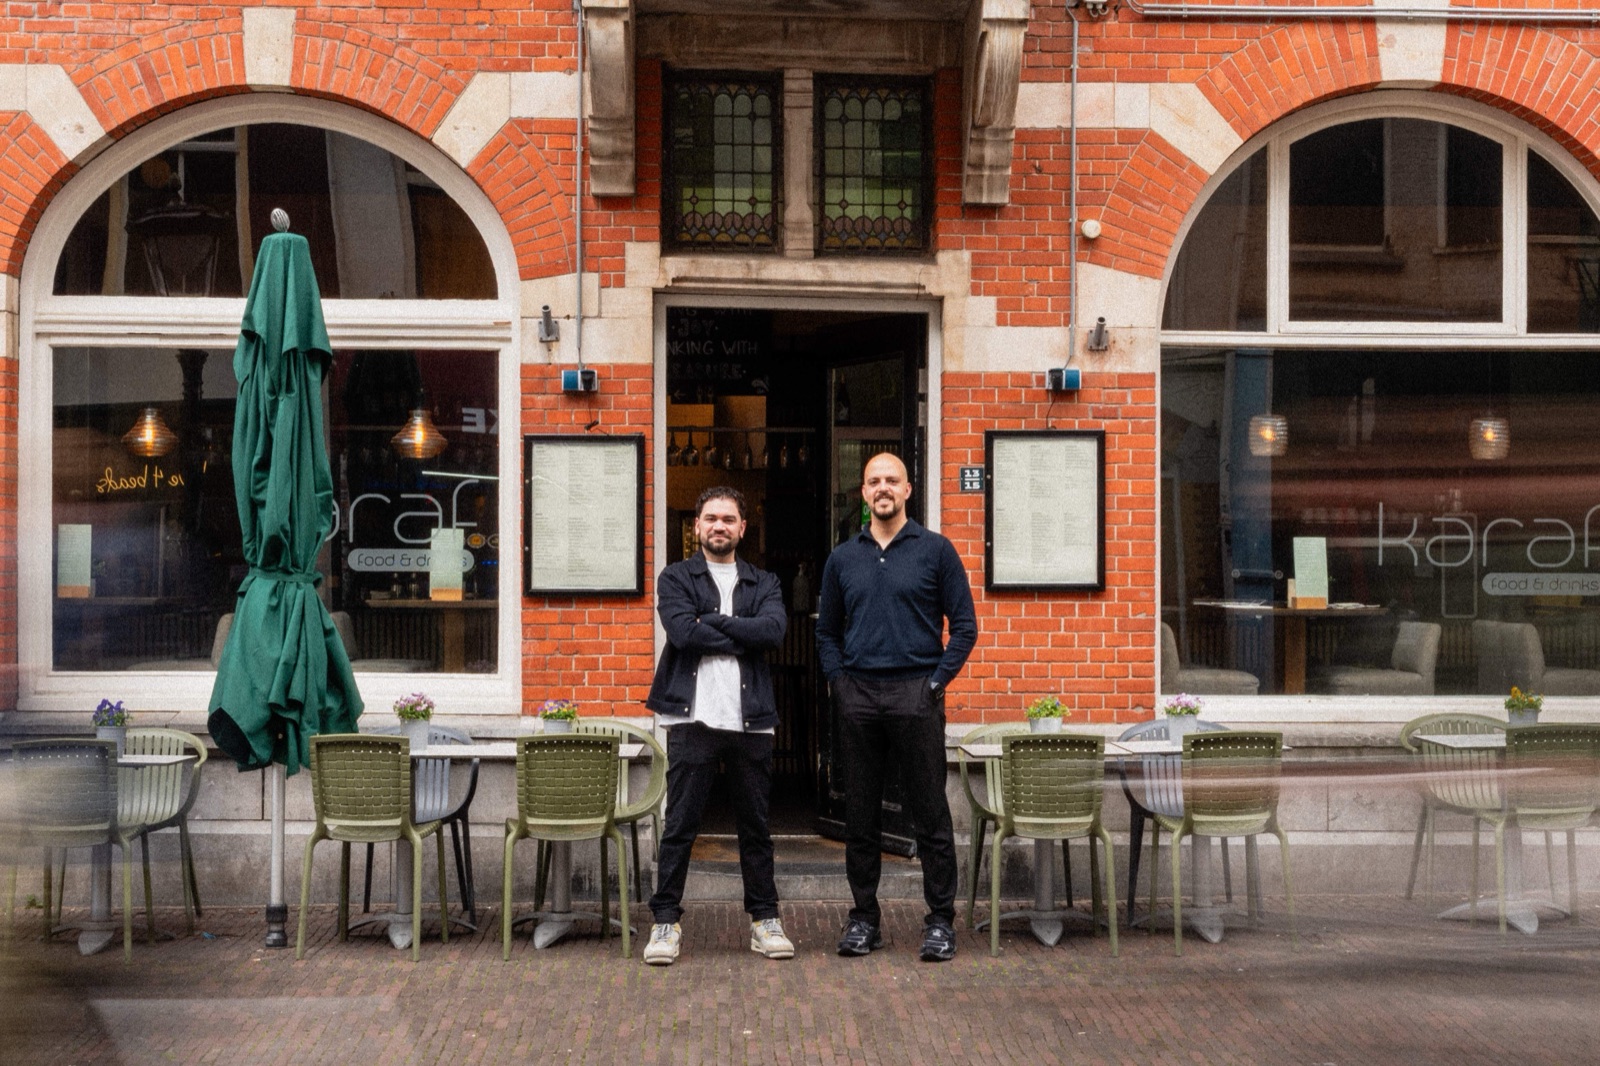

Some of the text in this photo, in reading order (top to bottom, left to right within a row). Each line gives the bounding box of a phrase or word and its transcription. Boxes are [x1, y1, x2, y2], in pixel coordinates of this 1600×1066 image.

[721, 340, 759, 356] WITH
[964, 469, 980, 478] 13
[964, 481, 981, 490] 15
[325, 479, 481, 545] raf
[1377, 501, 1600, 568] karaf
[357, 553, 468, 568] food & drs
[1490, 578, 1599, 591] food & drinks
